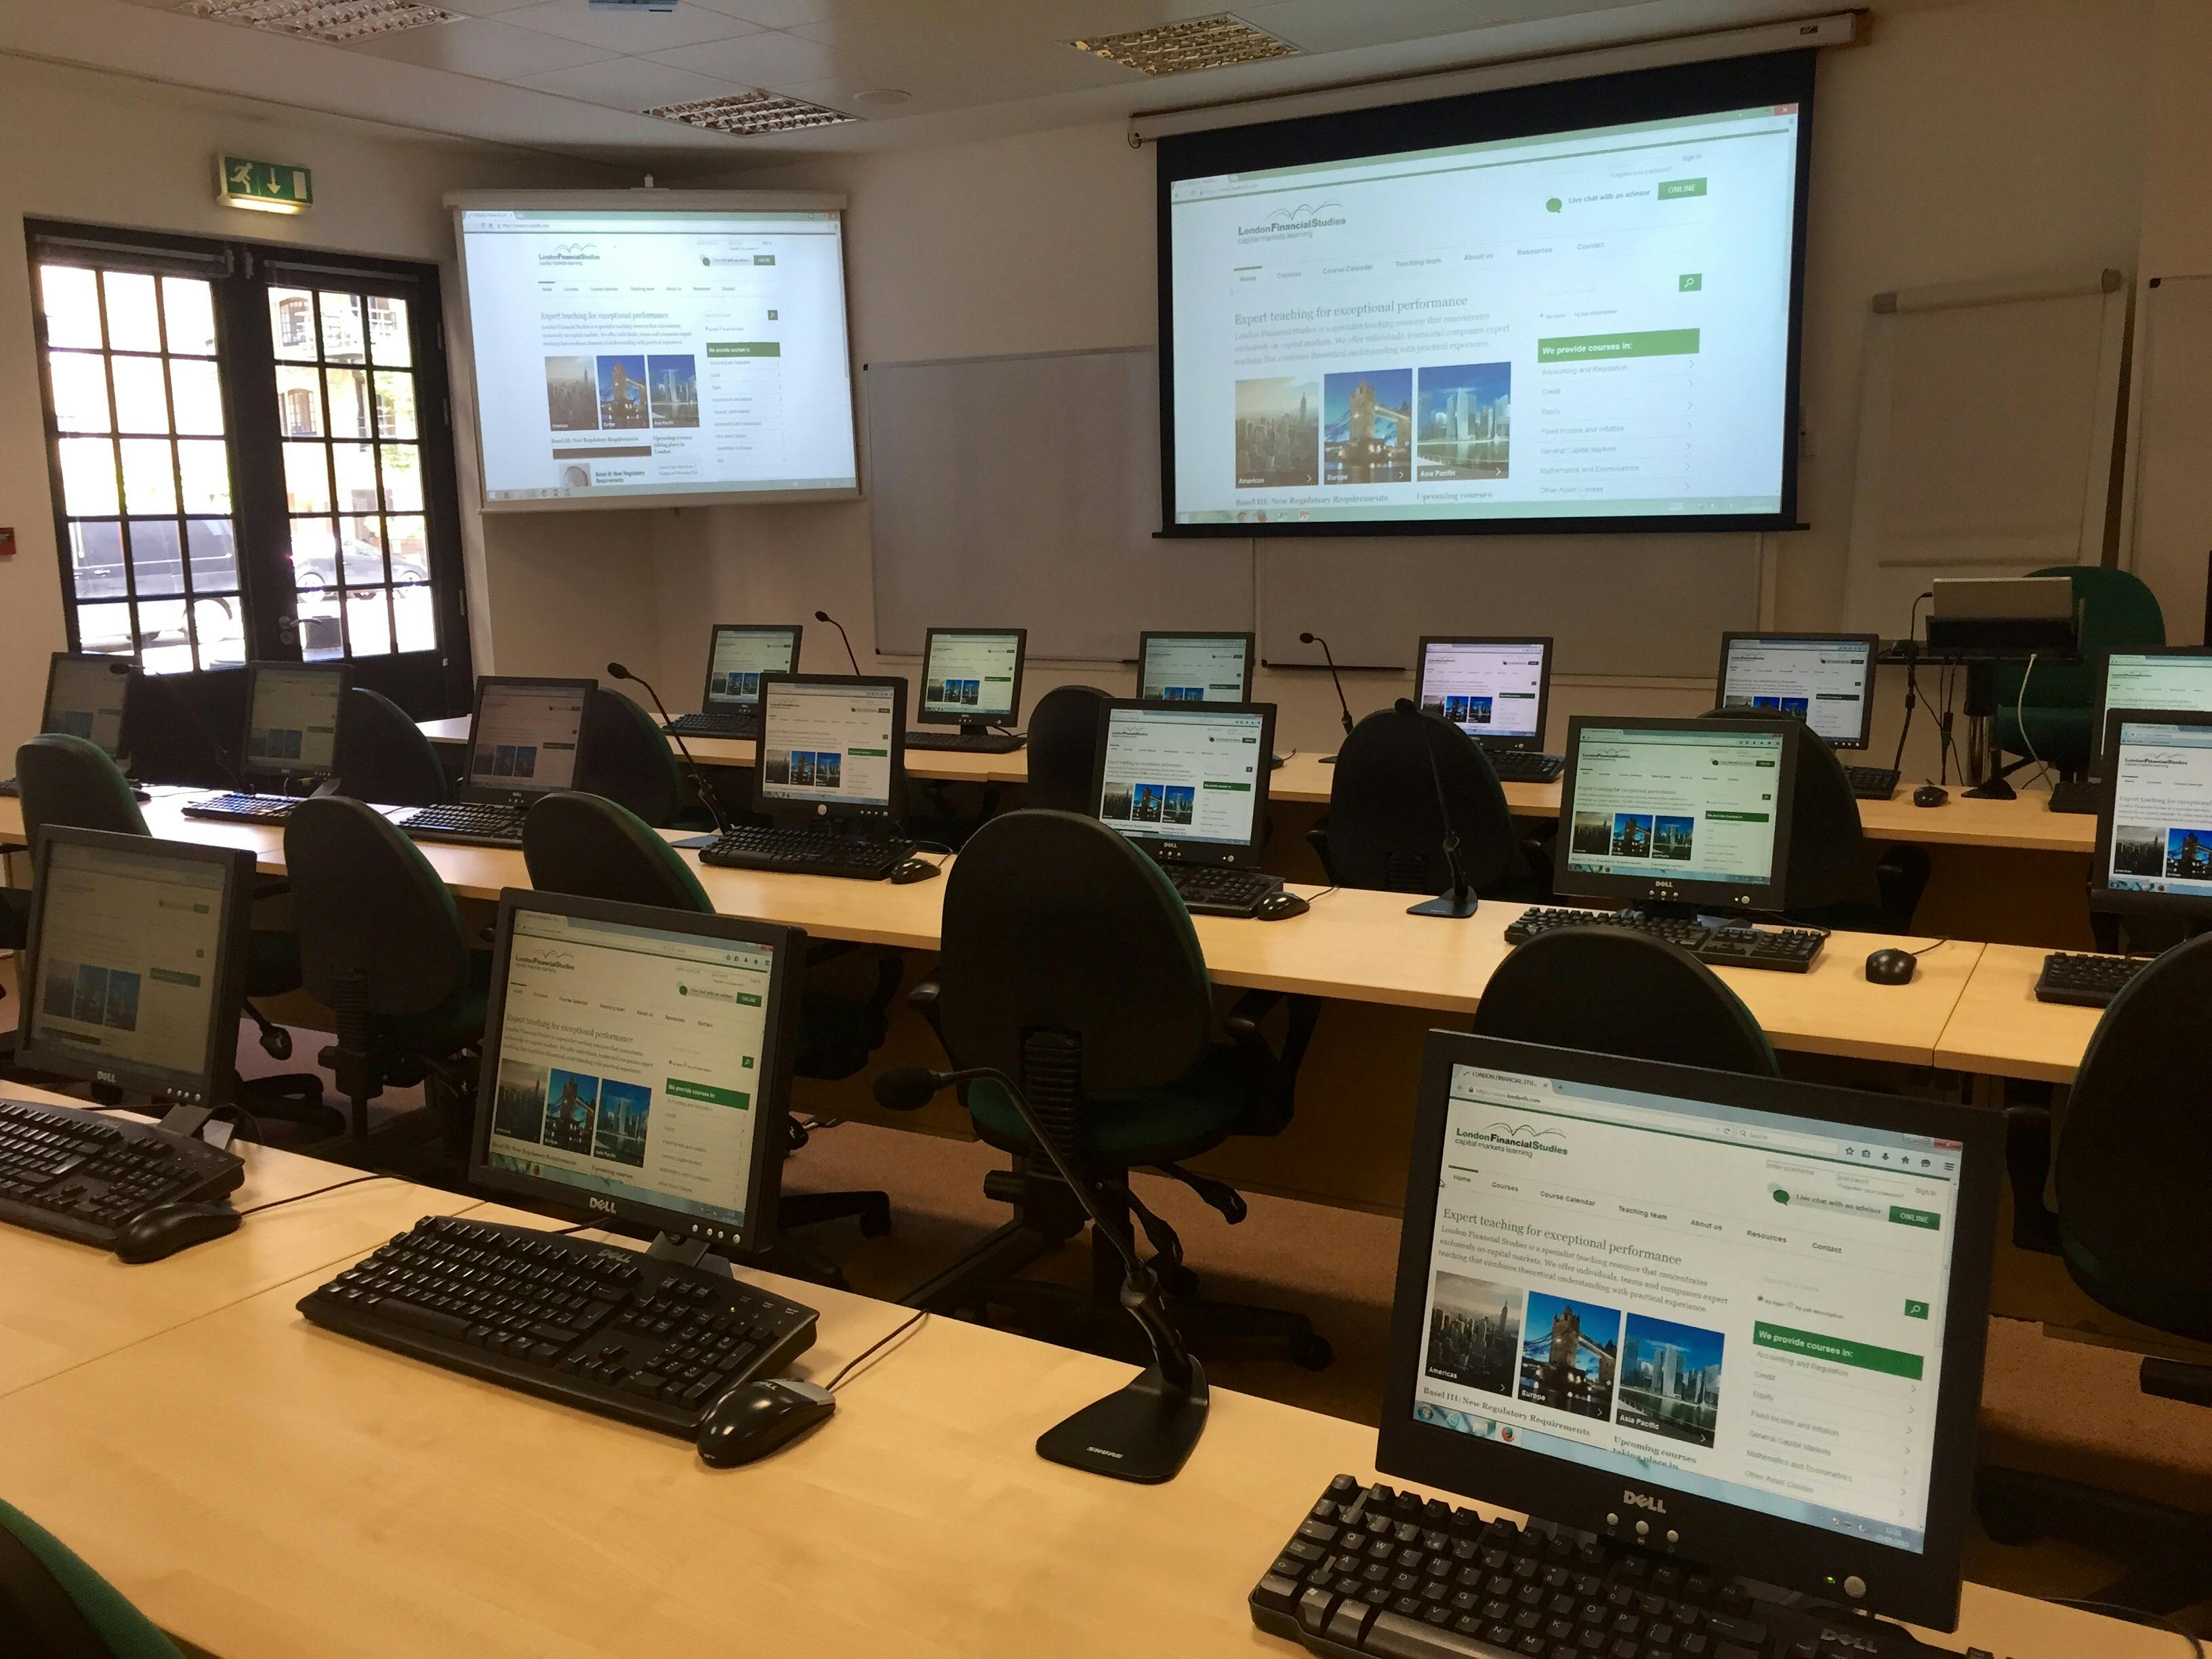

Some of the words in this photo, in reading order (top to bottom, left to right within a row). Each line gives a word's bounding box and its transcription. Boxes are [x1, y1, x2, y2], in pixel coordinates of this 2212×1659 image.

[1668, 184, 1696, 193] ONLINE
[1238, 216, 1345, 235] LondonFinancialStudies
[1237, 236, 1258, 244] capital
[1260, 233, 1285, 241] markets
[1577, 241, 1604, 250] Contact
[1235, 312, 1267, 325] Expert
[1270, 310, 1313, 321] teaching
[1317, 308, 1331, 317] for
[1334, 302, 1393, 316] exceptional
[1398, 298, 1467, 313] performance
[1557, 346, 1585, 354] provide
[97, 1071, 116, 1082] DELL
[1456, 1127, 1568, 1155] LondonFinancialStudies
[1477, 1143, 1504, 1151] markets
[1505, 1146, 1532, 1158] learning
[590, 1197, 616, 1214] DELL
[1796, 1193, 1809, 1202] Live
[1855, 1204, 1881, 1214] advisor
[1453, 1174, 1471, 1183] Home
[1492, 1181, 1518, 1191] Courses
[1540, 1191, 1563, 1200] Course
[1565, 1195, 1595, 1206] Calendar
[1618, 1206, 1648, 1218] Teaching
[1650, 1211, 1667, 1220] team
[1690, 1219, 1711, 1229] About
[1746, 1229, 1786, 1243] Resources
[1811, 1242, 1843, 1254] Contact
[1900, 1212, 1929, 1223] ONLINE
[1443, 1208, 1478, 1224] Expert
[1480, 1215, 1524, 1236] teaching
[1526, 1225, 1540, 1236] for
[1544, 1231, 1606, 1250] exceptional
[1609, 1244, 1681, 1265] performance
[597, 1249, 633, 1264] DELL
[1441, 1225, 1466, 1236] London
[1468, 1231, 1500, 1243] Financial
[1502, 1237, 1527, 1248] Studies
[1542, 1248, 1574, 1258] specialist
[1576, 1253, 1607, 1267] teaching
[1610, 1261, 1641, 1272] resource
[1642, 1267, 1656, 1275] that
[1658, 1271, 1708, 1286] concentrates
[1438, 1249, 1467, 1262] teaching
[1469, 1255, 1482, 1264] that
[1483, 1260, 1516, 1271] combines
[1518, 1266, 1556, 1279] theoretical
[1557, 1276, 1610, 1293] understanding
[1612, 1287, 1628, 1295] with
[1629, 1292, 1663, 1303] practical
[1440, 1239, 1475, 1252] exclusively
[1487, 1249, 1511, 1258] capital
[1544, 1259, 1556, 1267] We
[1557, 1263, 1574, 1271] offer
[1620, 1275, 1642, 1286] teams
[1644, 1282, 1659, 1290] and
[1660, 1286, 1702, 1298] companies
[1704, 1294, 1728, 1304] expert
[1759, 1330, 1771, 1340] We
[1773, 1335, 1805, 1347] provide
[1806, 1342, 1841, 1355] courses
[1842, 1348, 1853, 1357] in:
[1429, 1366, 1457, 1379] Americas
[1757, 1351, 1794, 1366] Accounting
[1811, 1362, 1848, 1376] Regulation
[1754, 1370, 1776, 1381] Credit
[1522, 1389, 1545, 1401] Europe
[1752, 1391, 1773, 1402] Equity
[1423, 1387, 1445, 1399] Basel
[1446, 1393, 1460, 1403] III:
[1462, 1397, 1480, 1408] New
[1481, 1402, 1526, 1421] Regulatory
[1530, 1414, 1590, 1436] Requirements
[1620, 1414, 1632, 1423] Asia
[1635, 1418, 1658, 1430] Pacific
[1086, 1446, 1124, 1459] SHURE
[1614, 1437, 1658, 1456] Upcoming
[1660, 1450, 1697, 1464] courses
[1624, 1490, 1666, 1513] DELL
[1820, 1628, 1878, 1654] DELL
